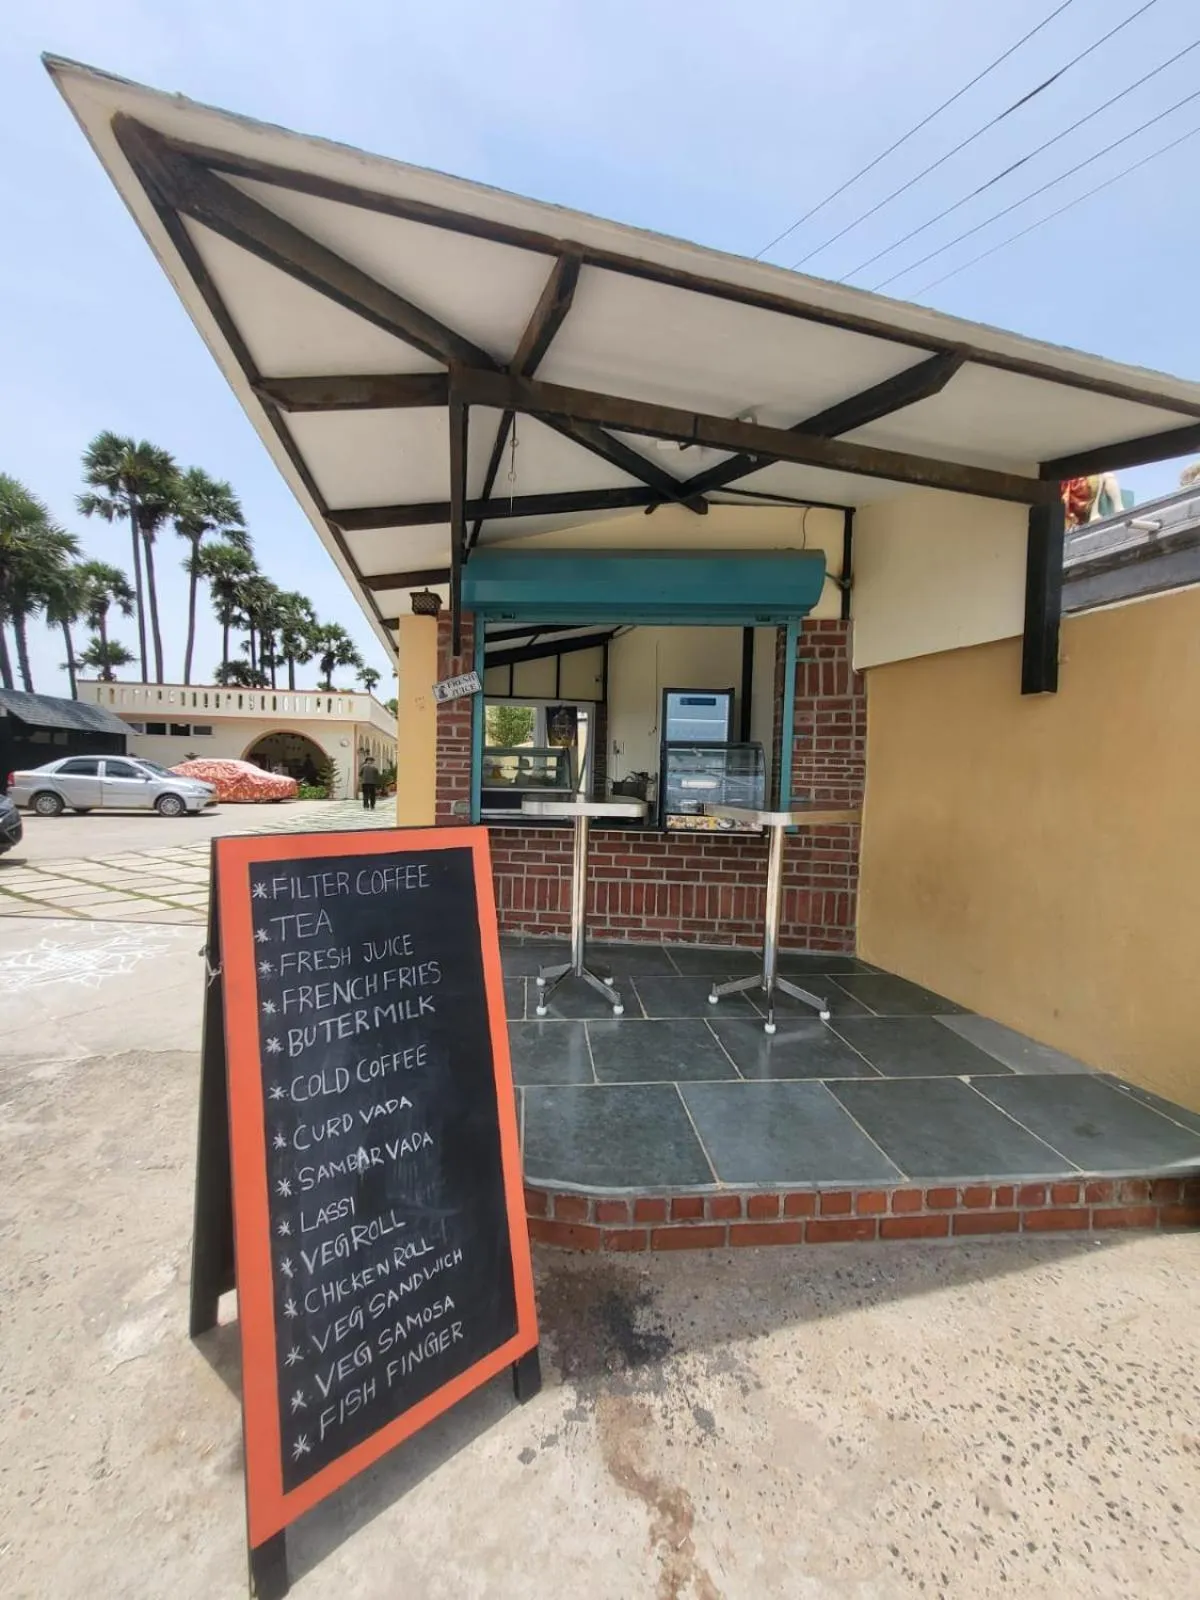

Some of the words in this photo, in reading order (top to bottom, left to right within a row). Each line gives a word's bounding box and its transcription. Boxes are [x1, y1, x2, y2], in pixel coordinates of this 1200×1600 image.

[272, 872, 349, 900] FILTER
[356, 864, 430, 896] COFFEE
[270, 909, 333, 941] TEA
[280, 946, 351, 976] FRESH
[362, 934, 414, 962] JUICE
[282, 972, 378, 1014] FRENCH
[383, 962, 442, 991] FRIES
[290, 1068, 350, 1101] COLD
[356, 1044, 428, 1083] COFFEE
[293, 1114, 352, 1150] CURD
[359, 1096, 414, 1124] VADA
[299, 1146, 384, 1191] SAMBAR
[385, 1131, 434, 1161] VADA
[301, 1197, 355, 1233] LASSI
[352, 1209, 406, 1251] ROLL
[305, 1261, 390, 1314] CHICKEN
[394, 1238, 434, 1271] ROLL
[312, 1306, 365, 1354] VEG
[368, 1248, 463, 1319] SANDWICH
[314, 1344, 373, 1398] VEG
[379, 1296, 455, 1354] SAMOSA
[319, 1378, 376, 1441] FISH
[387, 1320, 464, 1387] FINGER
